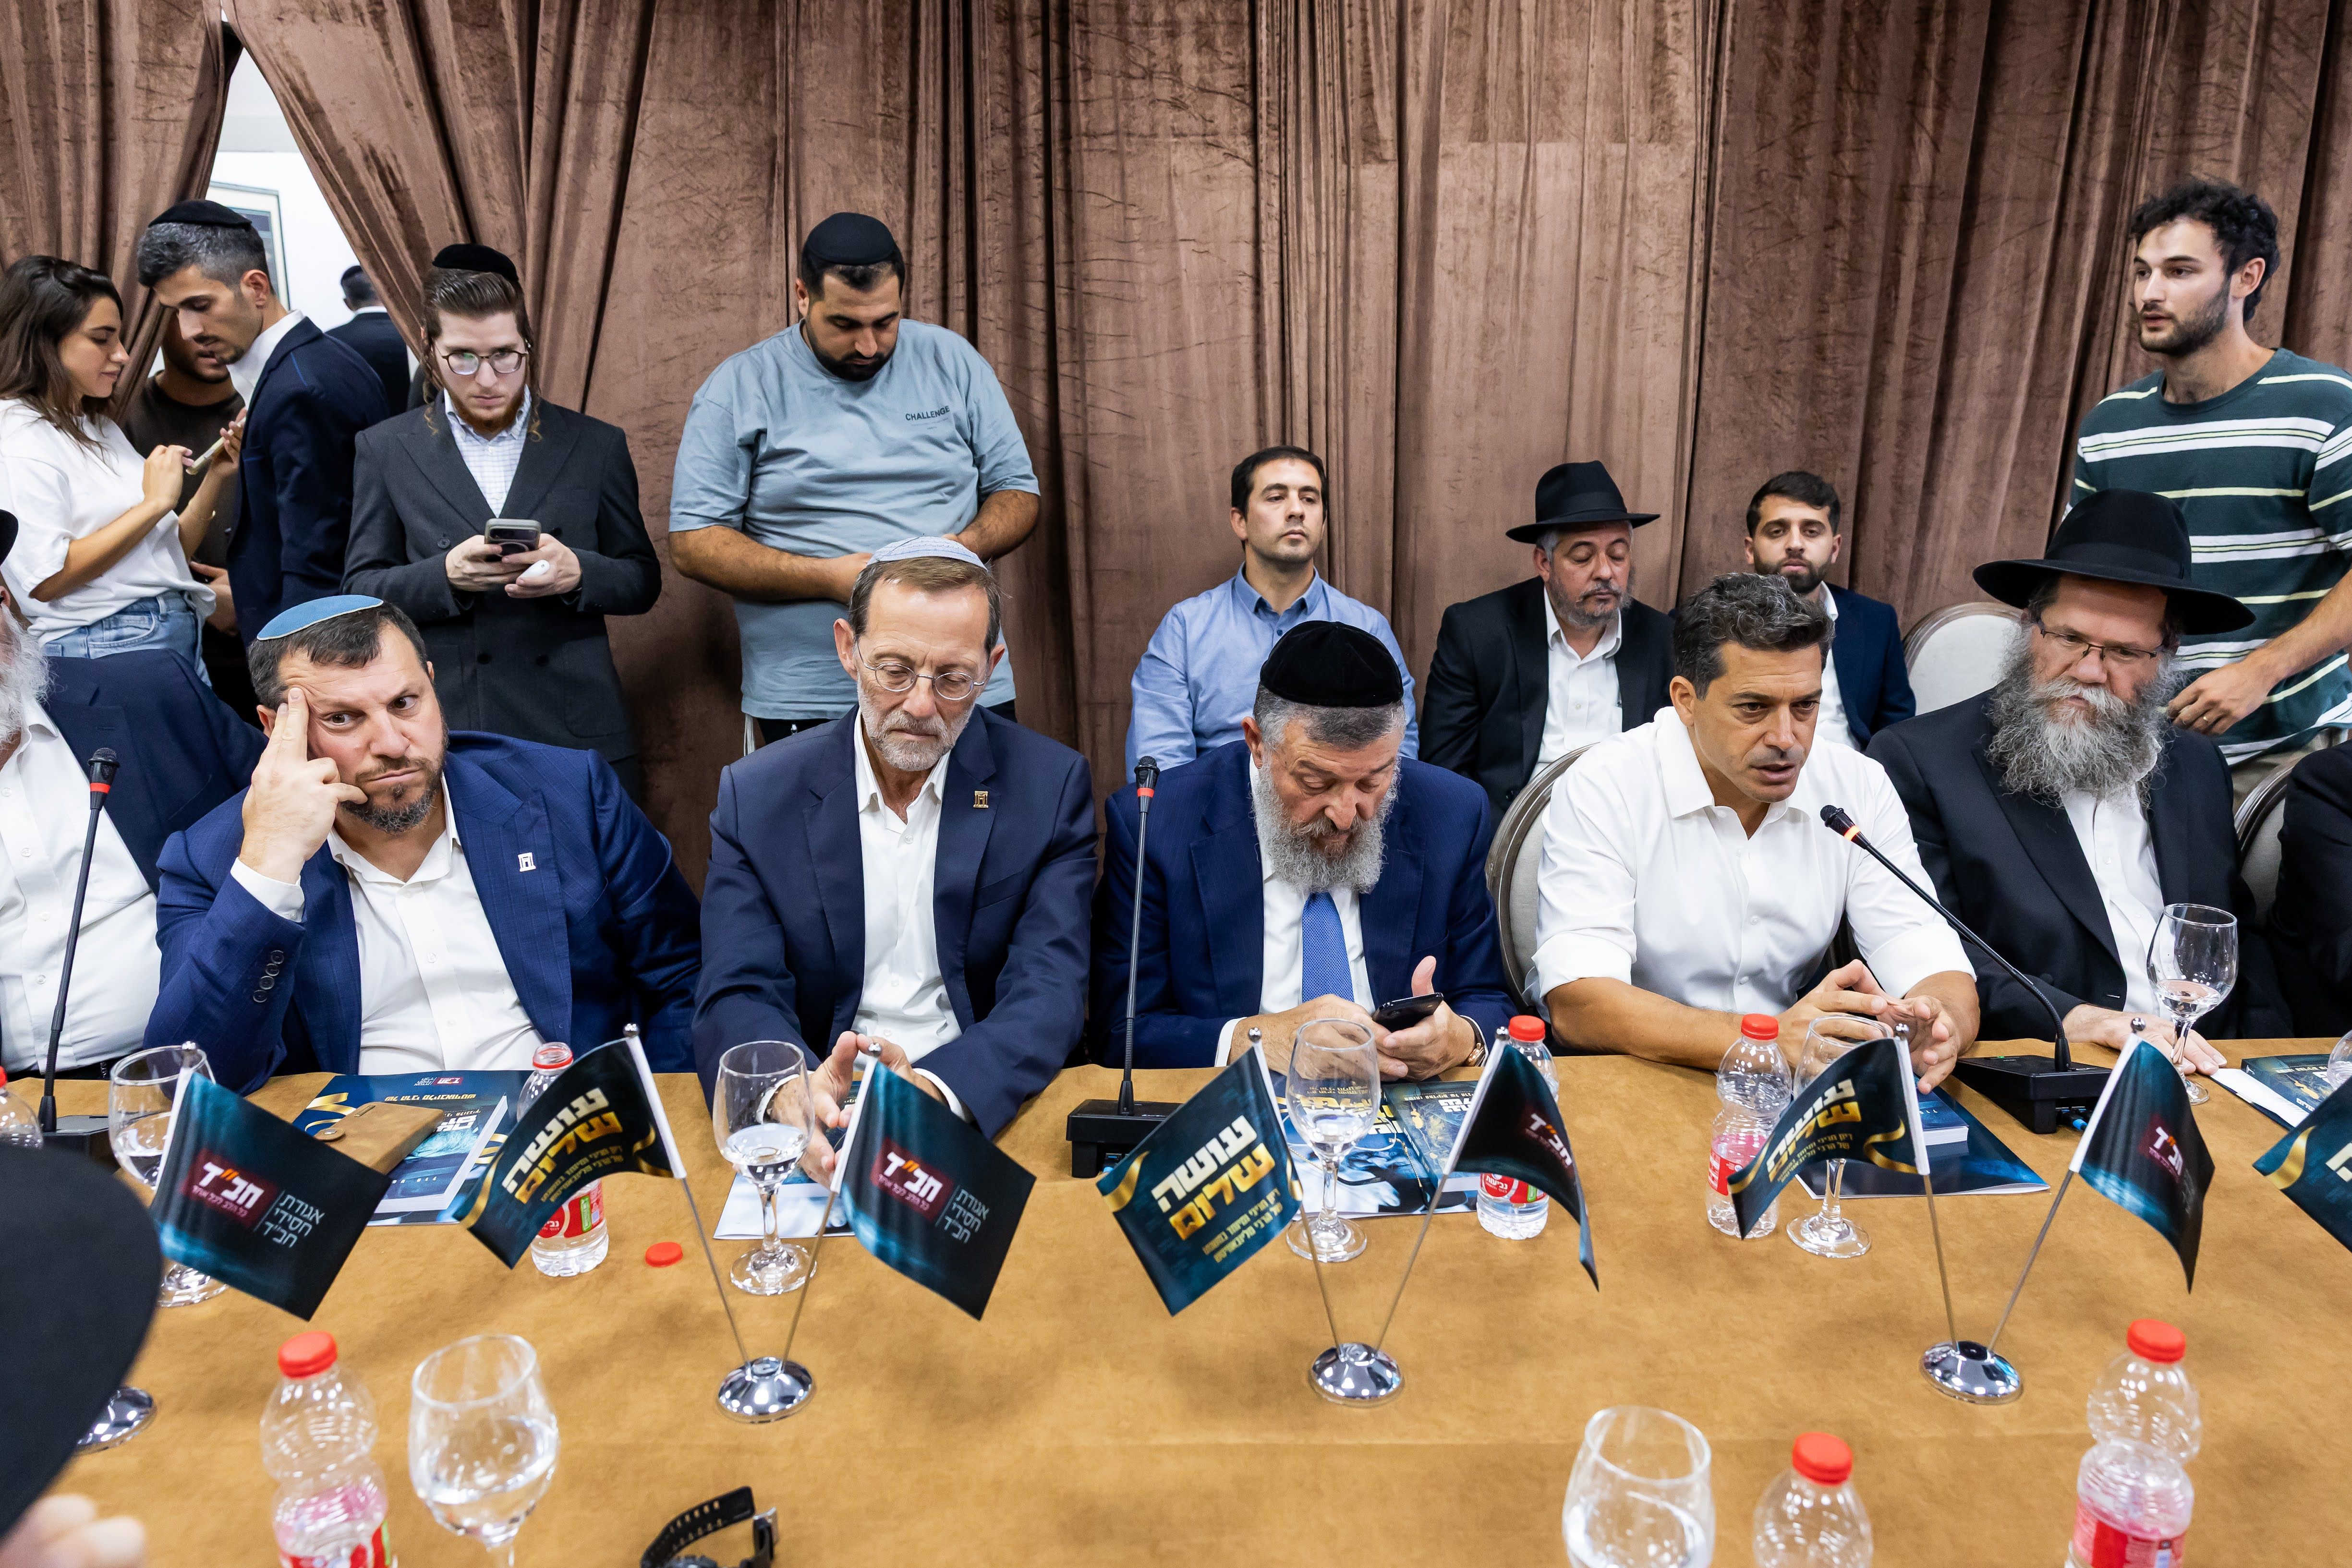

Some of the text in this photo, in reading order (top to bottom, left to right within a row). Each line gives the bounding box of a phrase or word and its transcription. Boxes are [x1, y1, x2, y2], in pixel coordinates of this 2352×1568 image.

[905, 405, 950, 421] CHALLENGE
[501, 1087, 609, 1194] עושה
[1530, 1113, 1573, 1166] חב"ד
[1766, 1078, 1856, 1173] עושה
[1769, 1101, 1862, 1182] שלום
[514, 1111, 623, 1204] שלום
[884, 1152, 943, 1203] חב"ד
[1151, 1115, 1258, 1213] עושה
[199, 1161, 264, 1209] חב"ד
[957, 1188, 990, 1221] אגודת
[1169, 1142, 1276, 1241] שלום
[1486, 1175, 1508, 1190] נביעות
[274, 1207, 312, 1237] חסידי
[279, 1194, 325, 1225] אגודת
[944, 1215, 971, 1244] חב"ד
[951, 1201, 982, 1233] חסידי
[263, 1221, 298, 1248] חב"ד
